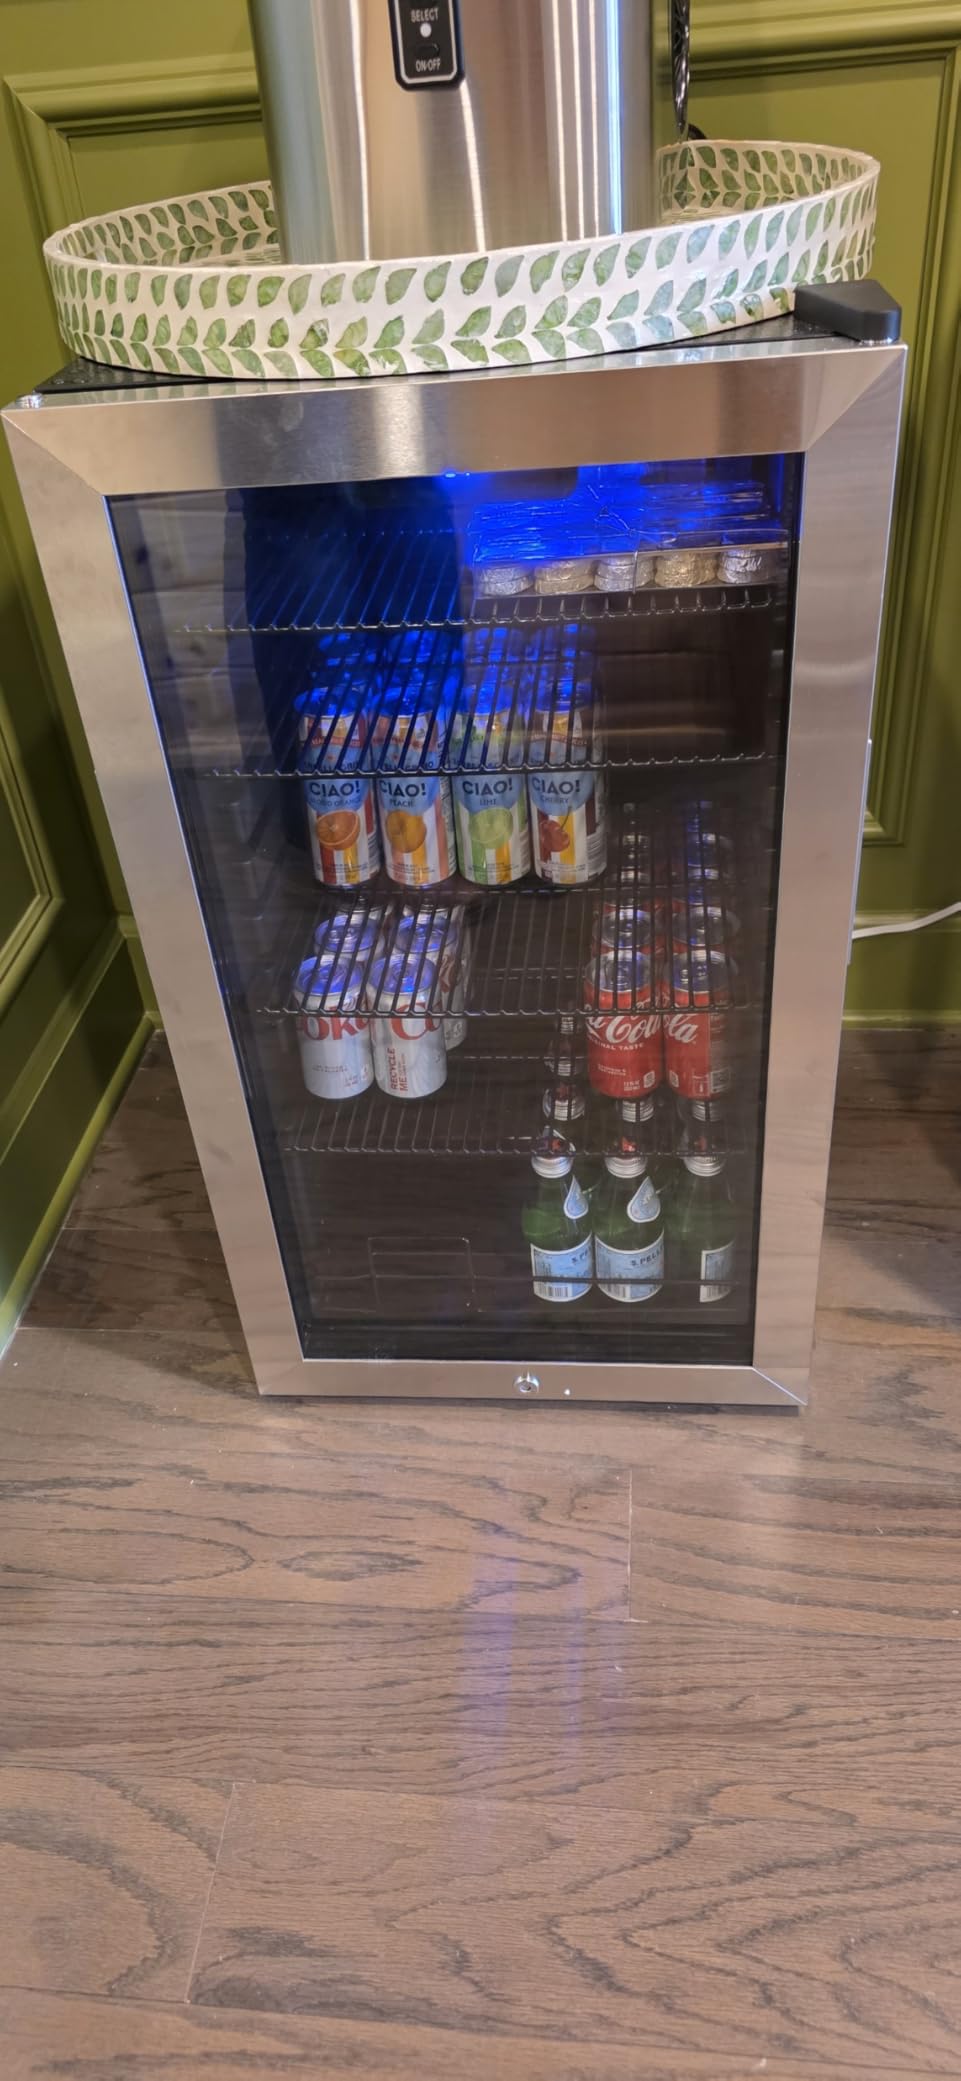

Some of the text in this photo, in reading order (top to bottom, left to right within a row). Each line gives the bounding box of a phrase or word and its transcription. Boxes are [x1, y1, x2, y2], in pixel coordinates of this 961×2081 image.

[410, 8, 439, 22] SELECT
[309, 780, 361, 797] CIAO!
[379, 779, 427, 798] CIAO!
[462, 777, 513, 796] CIAO!
[531, 776, 580, 795] CIAO!
[618, 1042, 645, 1051] TASTE
[387, 1047, 398, 1090] RECYCLE
